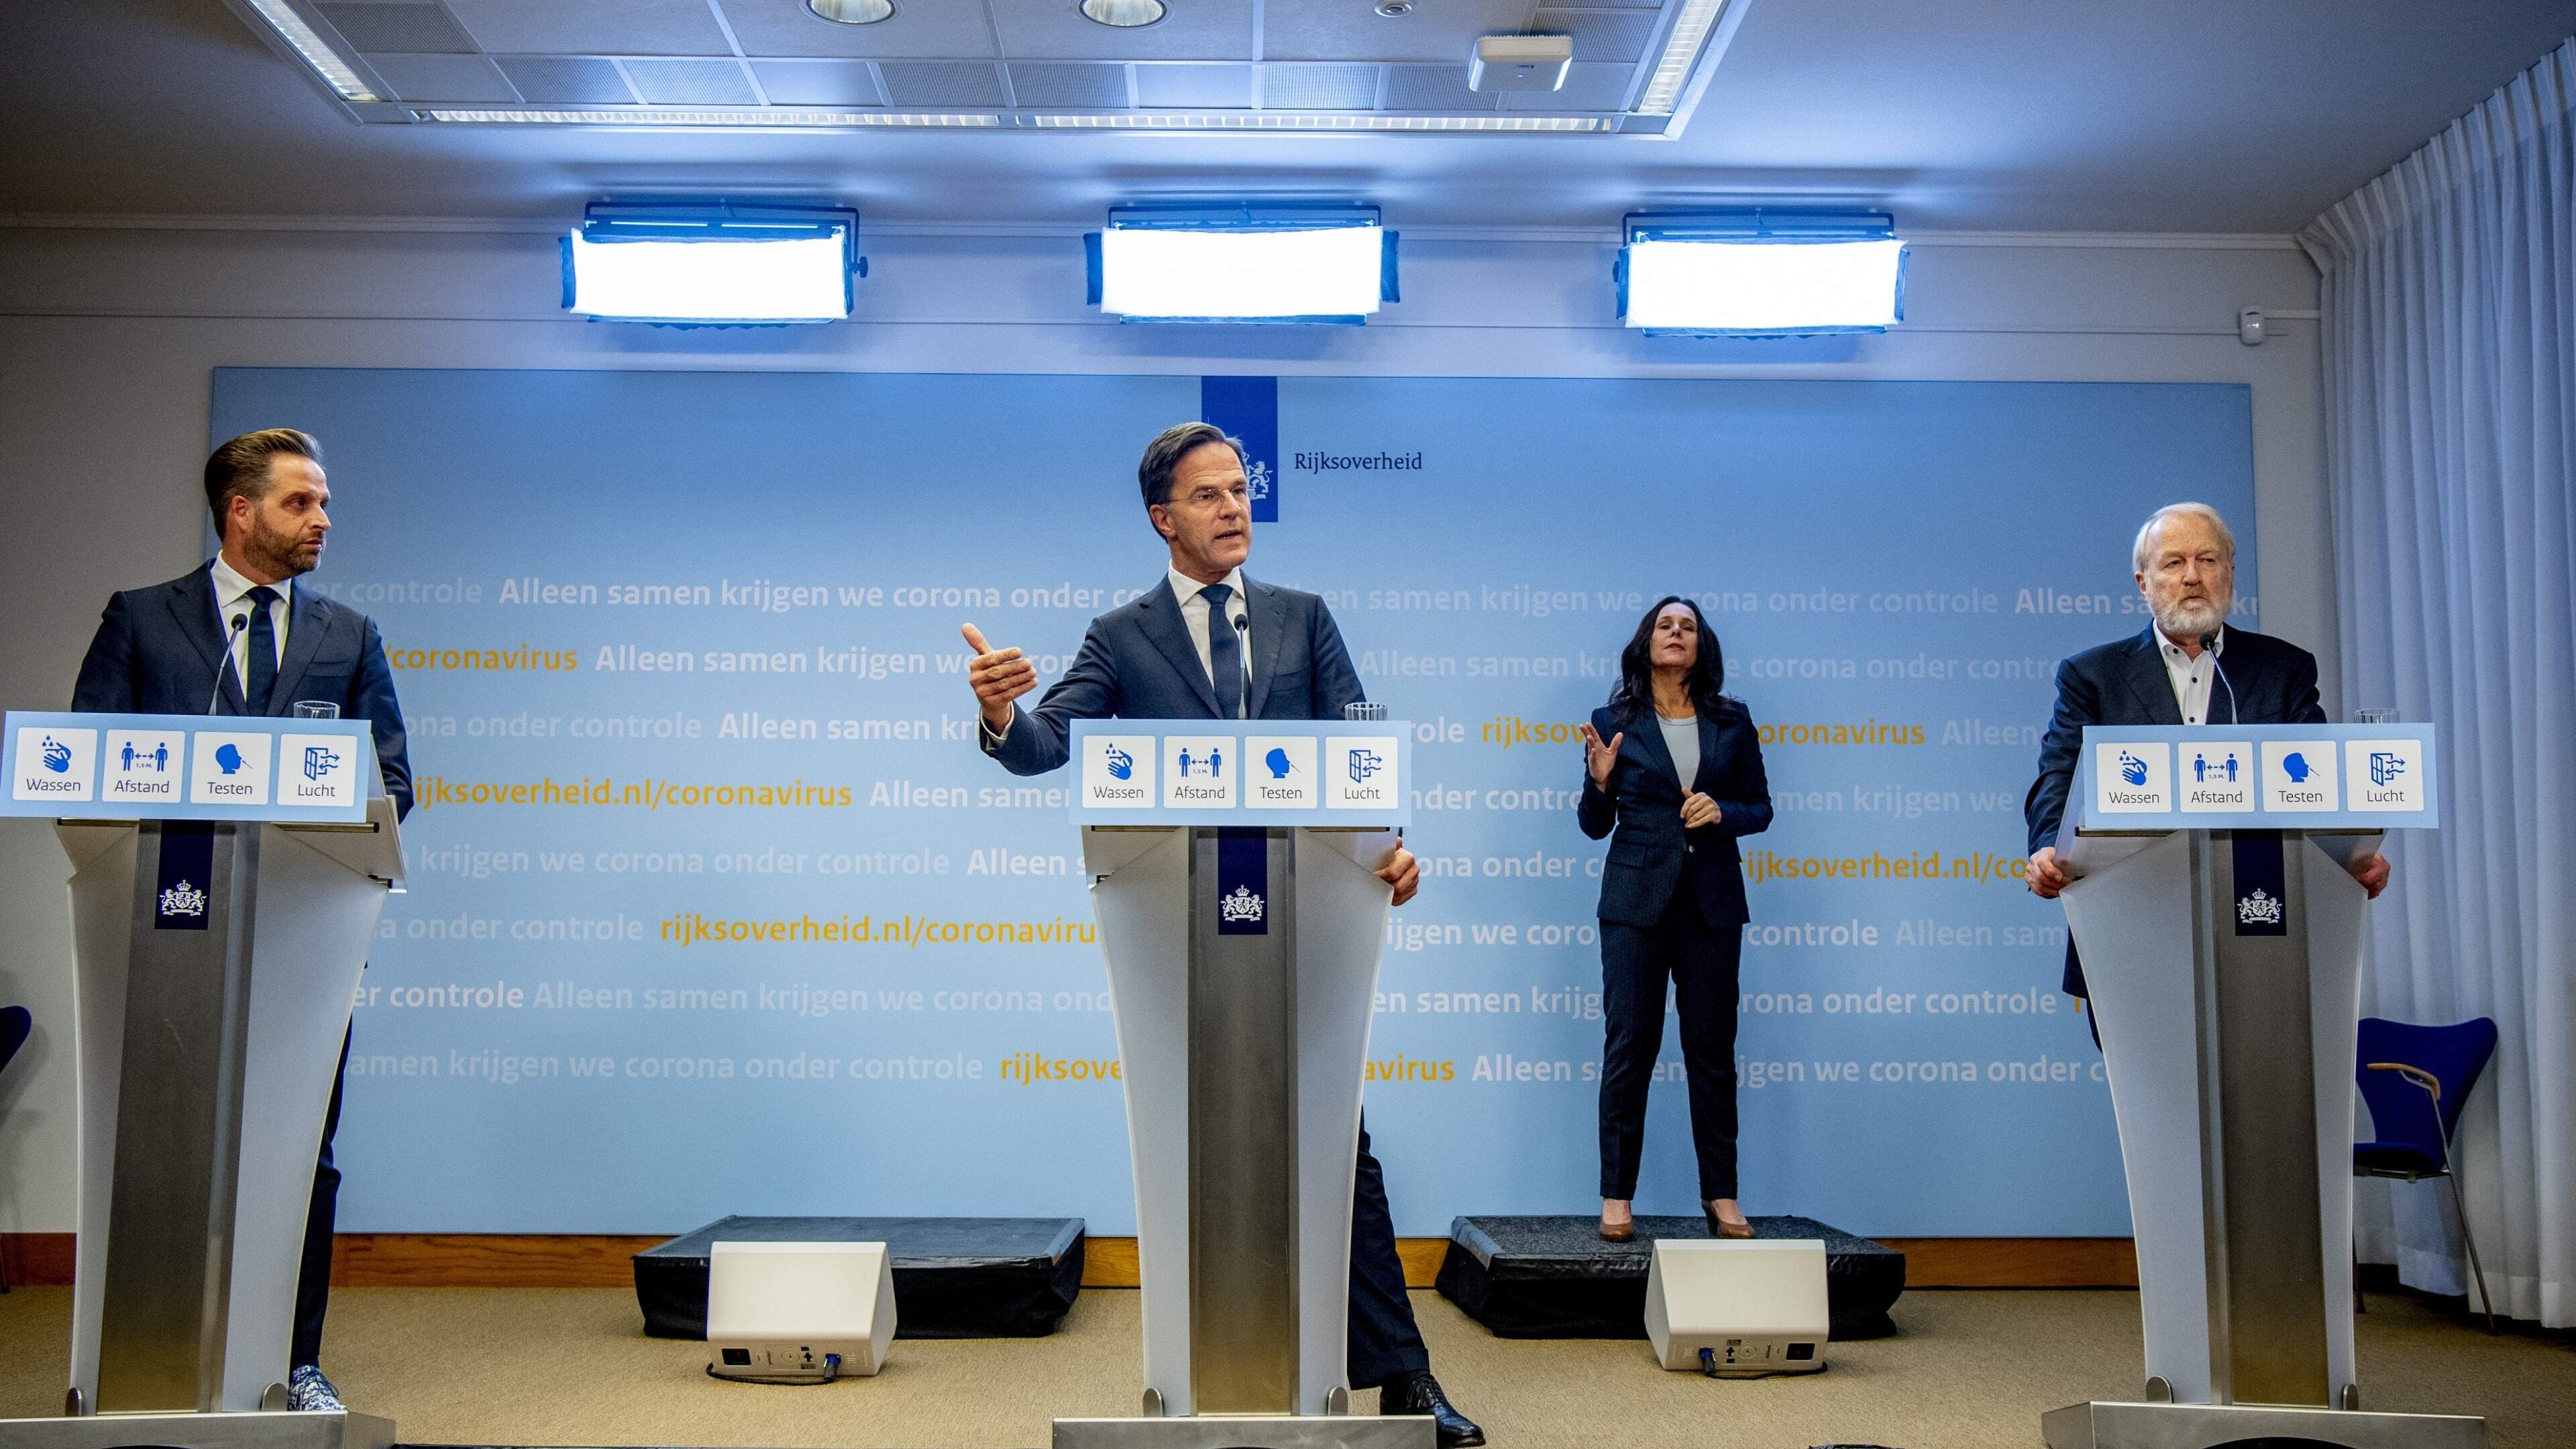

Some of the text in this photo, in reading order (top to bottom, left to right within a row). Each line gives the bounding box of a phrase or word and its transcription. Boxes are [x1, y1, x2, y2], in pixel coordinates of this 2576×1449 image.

[1294, 451, 1423, 475] Rijksoverheid
[350, 576, 482, 604] controle
[498, 578, 597, 605] Alleen
[607, 584, 710, 606] samen
[720, 579, 828, 613] krijgen
[839, 585, 883, 607] we
[893, 585, 1000, 608] corona
[1010, 582, 1106, 608] onder
[1368, 590, 1471, 610] samen
[1481, 584, 1589, 617] krijgen
[1598, 590, 1642, 611] we
[1768, 586, 1860, 612] onder
[1868, 588, 1999, 613] controle
[2015, 587, 2111, 614] Alleen
[596, 645, 694, 672] Alleen
[703, 651, 806, 673] samen
[818, 647, 926, 680] krijgen
[1360, 649, 1456, 676] Alleen
[1466, 656, 1569, 677] samen
[1750, 658, 1857, 679] corona
[1866, 653, 1959, 680] onder
[467, 710, 562, 737] onder
[570, 711, 702, 739] controle
[718, 713, 818, 739] Alleen
[826, 718, 931, 740] samen
[1941, 719, 2037, 746] Alleen
[26, 777, 81, 792] Wassen
[114, 780, 170, 794] Afstand
[207, 782, 253, 796] Testen
[297, 784, 336, 798] Lucht
[414, 775, 853, 810] ijksoverheid.nl/coronavirus
[869, 780, 968, 807] Alleen
[1410, 783, 1477, 810] nder
[1485, 787, 1582, 810] contro
[1854, 785, 1960, 817] krijgen
[1970, 792, 2014, 812] we
[1093, 786, 1144, 799] Wassen
[1174, 786, 1225, 799] Afstand
[1259, 786, 1303, 800] Testen
[1344, 786, 1381, 800] Lucht
[2108, 790, 2160, 804] Wassen
[2190, 790, 2243, 804] Afstand
[2277, 790, 2323, 803] Testen
[2367, 788, 2405, 802] Lucht
[419, 845, 530, 879] krijgen
[540, 851, 585, 872] we
[594, 851, 704, 873] corona
[713, 847, 808, 874] onder
[817, 849, 950, 875] controle
[967, 849, 1067, 875] Alleen
[1483, 851, 1576, 878] onder
[407, 912, 502, 939] onder
[510, 913, 644, 941] controle
[661, 913, 1096, 949] rijksoverheid.nl/coronaviru
[1386, 917, 1462, 951] ijgen
[1471, 924, 1517, 946] we
[1526, 924, 1596, 946] coro
[1747, 918, 1878, 947] controle
[1895, 919, 1994, 947] Alleen
[2002, 926, 2067, 947] sam
[389, 980, 525, 1008] controle
[533, 981, 634, 1008] Alleen
[643, 987, 748, 1009] samen
[758, 983, 869, 1017] krijgen
[879, 989, 924, 1010] we
[934, 989, 1043, 1012] corona
[1416, 991, 1521, 1013] samen
[1531, 985, 1603, 1020] krijg
[1742, 992, 1813, 1014] rona
[1823, 986, 1917, 1014] onder
[1925, 986, 2057, 1014] controle
[350, 1054, 439, 1076] amen
[449, 1049, 559, 1083] krijgen
[568, 1055, 615, 1077] we
[624, 1057, 735, 1078] corona
[745, 1053, 839, 1079] onder
[849, 1053, 983, 1080] controle
[1471, 1053, 1571, 1081] Alleen
[1813, 1061, 1860, 1082] we
[1869, 1061, 1978, 1083] corona
[1986, 1055, 2082, 1083] onder
